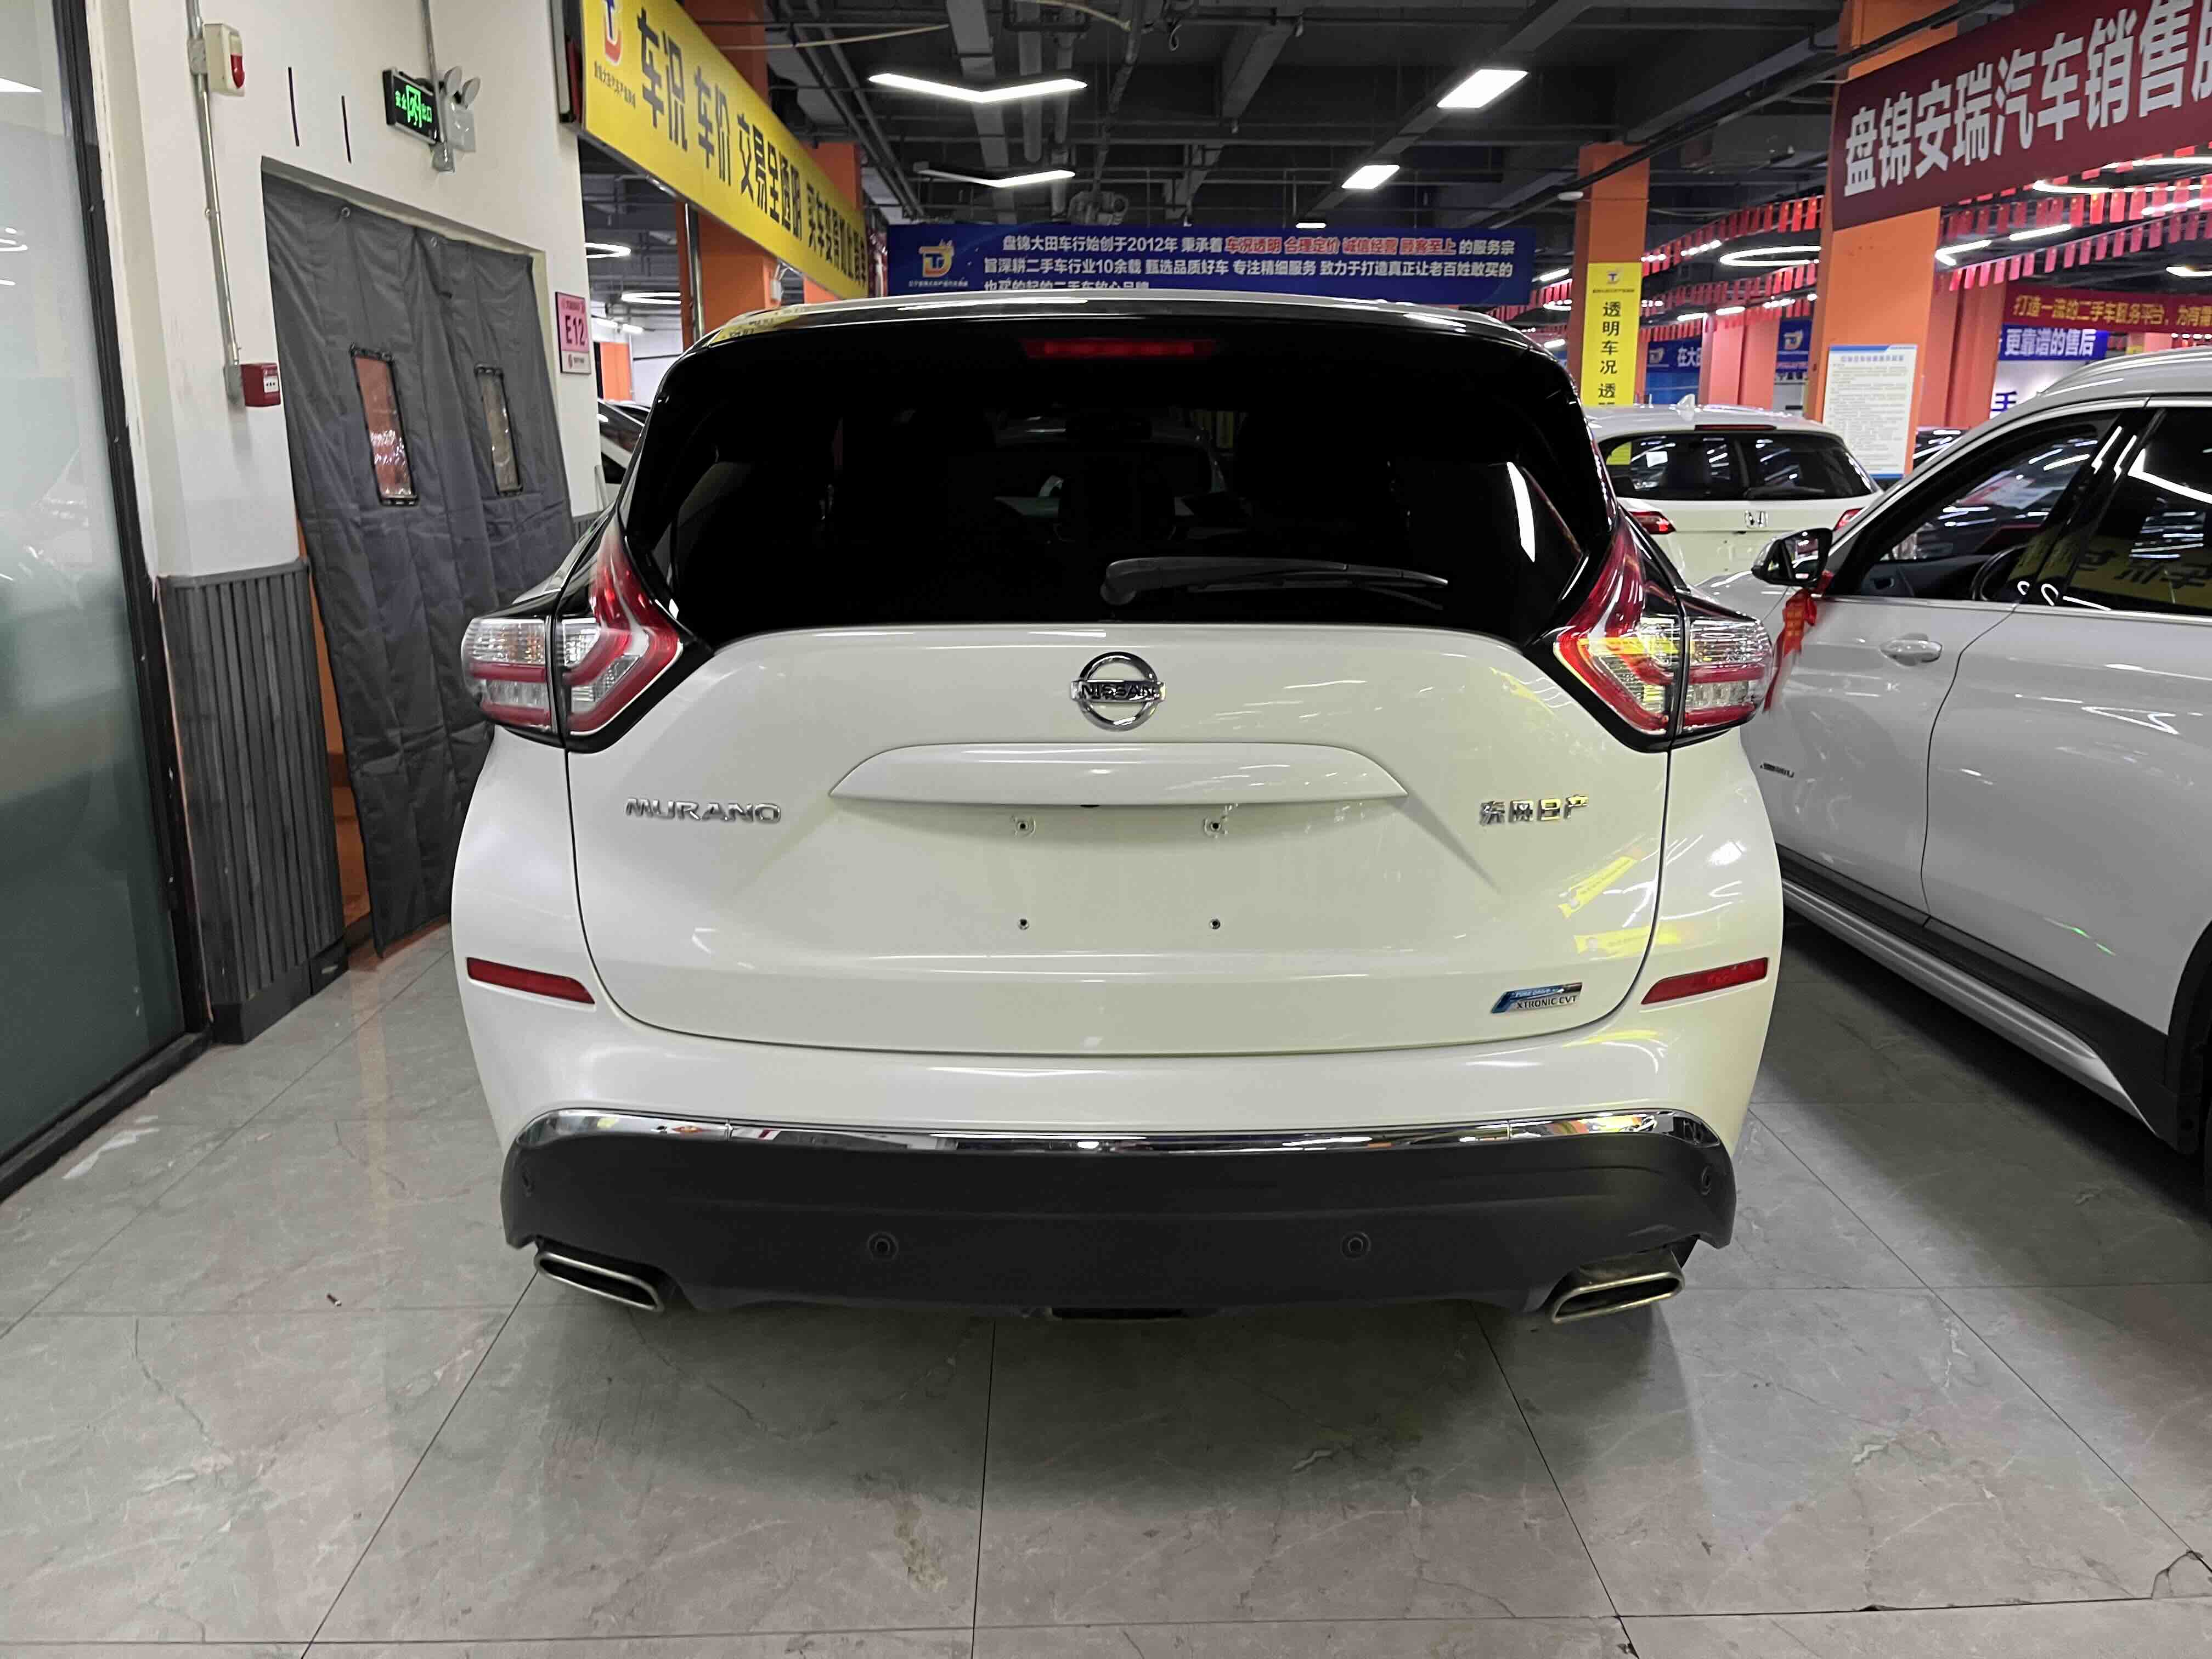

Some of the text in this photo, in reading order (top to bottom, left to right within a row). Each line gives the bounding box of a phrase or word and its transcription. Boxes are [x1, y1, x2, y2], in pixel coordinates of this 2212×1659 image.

[637, 7, 687, 153] 车况
[694, 65, 731, 187] 车价
[565, 314, 586, 346] E12
[625, 797, 782, 824] MURANO
[1517, 995, 1578, 1009] XTRONIC CVT
